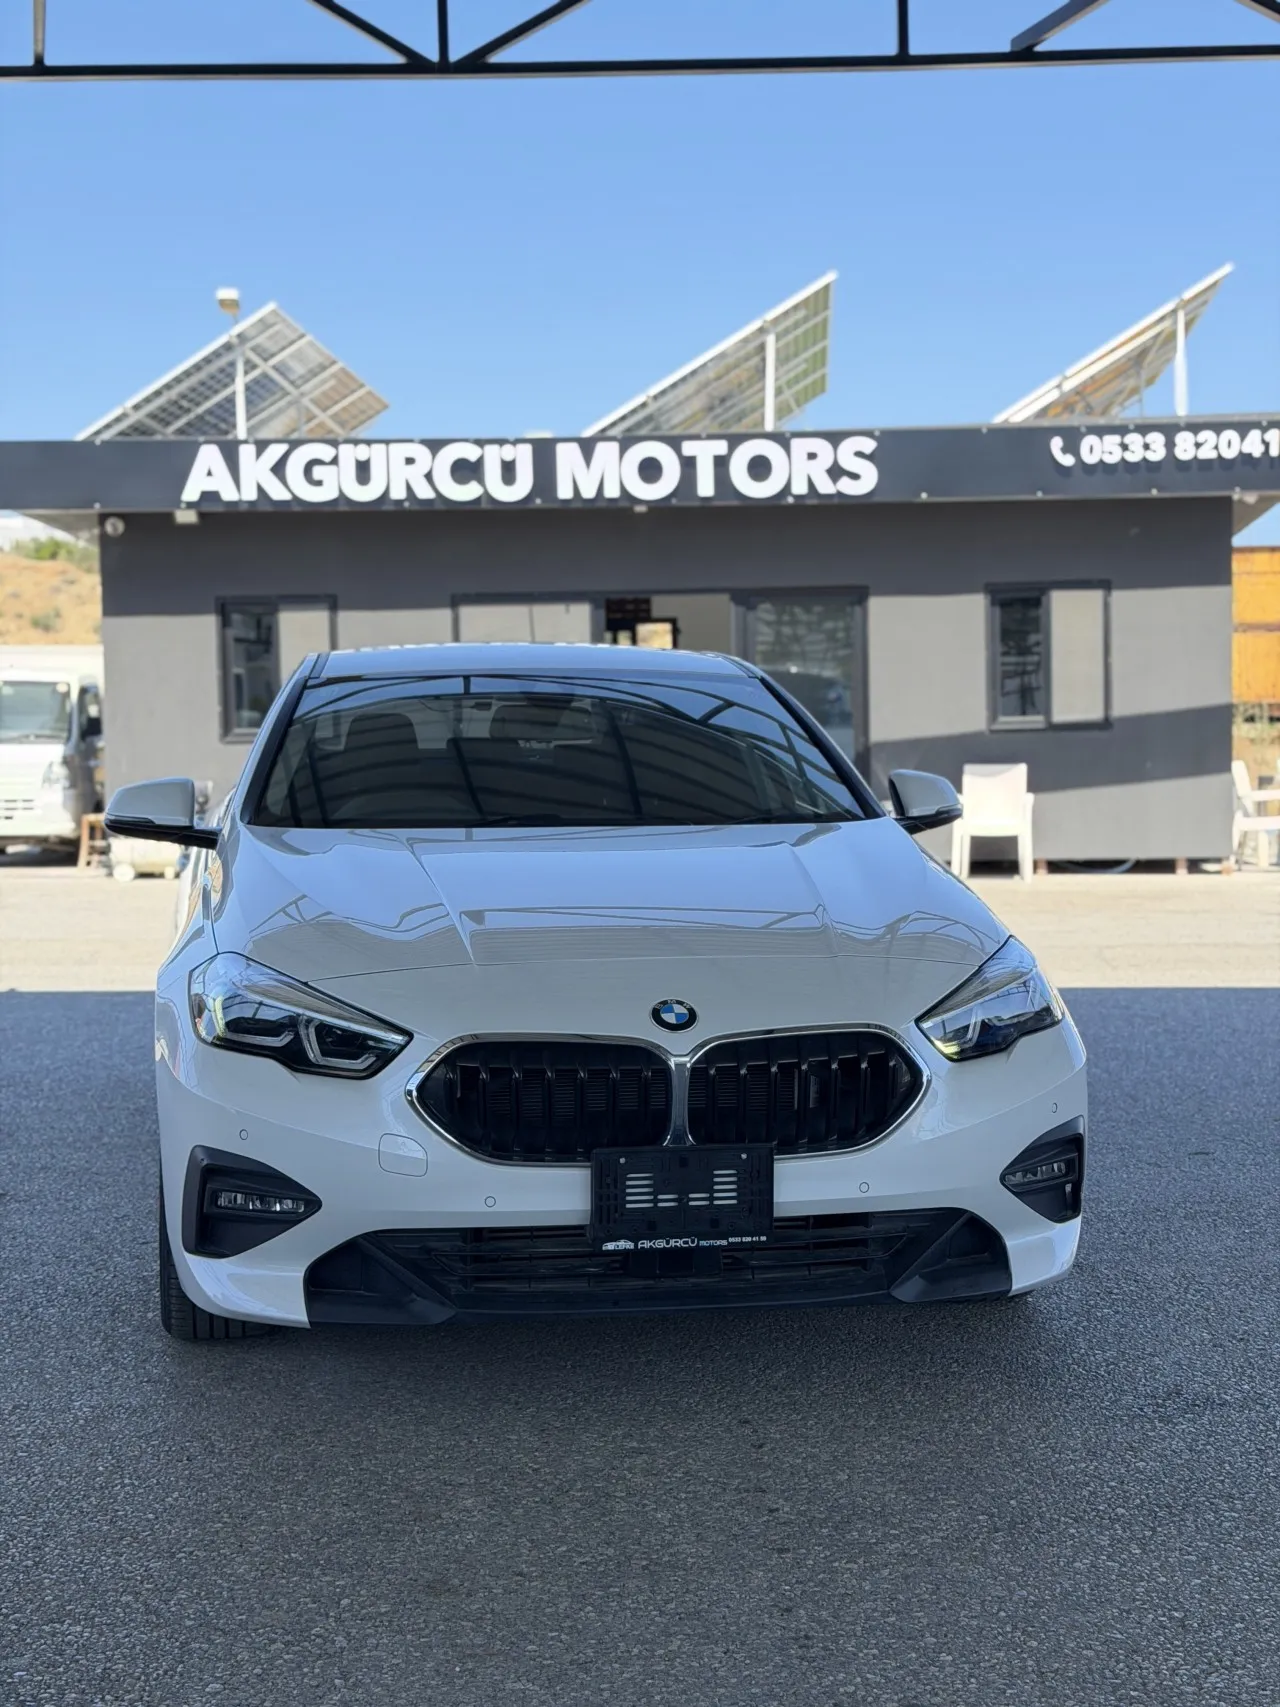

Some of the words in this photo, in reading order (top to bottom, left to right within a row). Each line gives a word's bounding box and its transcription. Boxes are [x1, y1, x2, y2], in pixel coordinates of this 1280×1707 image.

[1080, 432, 1167, 464] 0533
[1174, 428, 1280, 461] 82041
[181, 441, 534, 502] AKGÜRCÜ
[556, 436, 879, 500] MOTORS
[655, 999, 691, 1009] BMW
